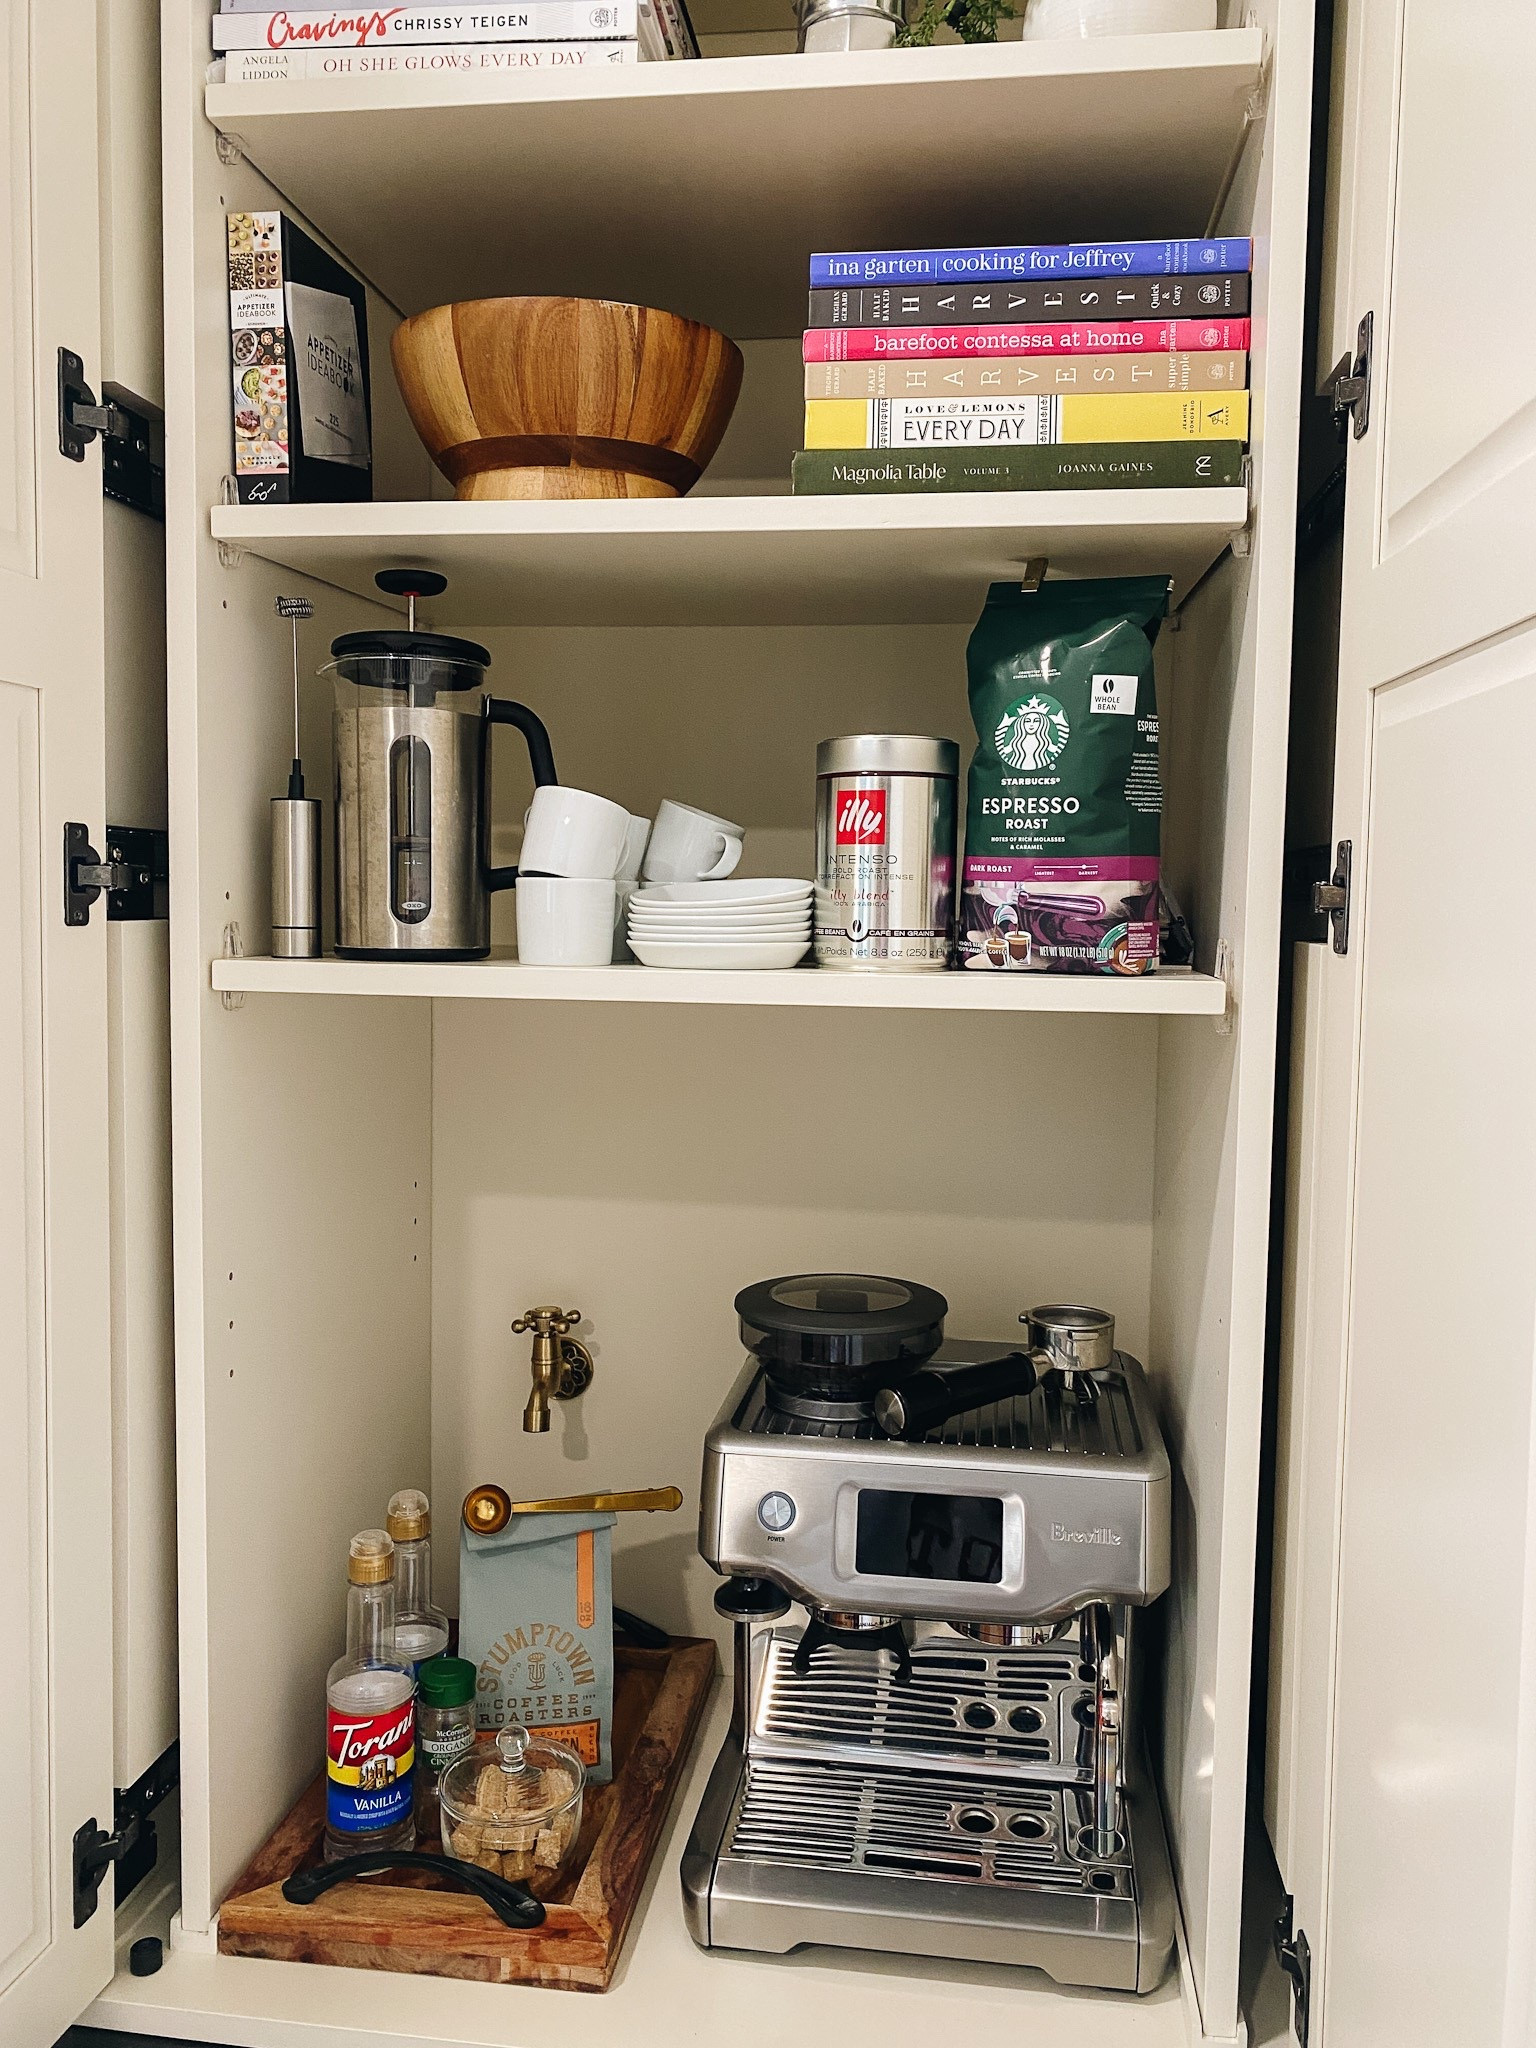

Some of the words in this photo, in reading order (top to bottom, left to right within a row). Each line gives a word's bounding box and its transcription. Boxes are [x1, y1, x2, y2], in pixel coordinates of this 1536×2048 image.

[267, 7, 409, 48] Cravings
[394, 17, 463, 31] CHRISSY
[470, 15, 528, 28] TEIGEN
[243, 55, 289, 65] ANGELA
[323, 58, 351, 73] OH
[359, 57, 398, 71] SHE
[405, 55, 472, 71] GLOWS
[480, 52, 542, 67] EVERY
[551, 51, 587, 65] DAY
[242, 71, 288, 80] LIDDON
[828, 258, 860, 276] ina
[864, 258, 930, 280] garten
[942, 252, 1025, 275] cooking
[1030, 251, 1059, 269] for
[1063, 248, 1135, 272] Jeffrey
[873, 293, 881, 318] HALF
[882, 289, 890, 321] BAKED
[1151, 283, 1160, 309] Quick
[1162, 291, 1170, 299] &
[1172, 284, 1182, 306] Cozy
[873, 333, 958, 352] barefoot
[964, 331, 1054, 350] contessa
[1059, 331, 1080, 347] at
[1086, 329, 1144, 347] home
[1158, 330, 1166, 345] ina
[1169, 322, 1177, 352] garten
[307, 333, 354, 378] APPETIZER
[868, 368, 876, 392] HALF
[878, 364, 886, 395] BAKED
[1168, 357, 1178, 388] super
[1179, 354, 1191, 391] simple
[904, 405, 945, 414] LOVE
[961, 402, 1026, 413] LEMONS
[903, 419, 973, 441] EVERY
[979, 418, 1026, 440] DAY
[832, 464, 902, 484] Magnolia
[905, 463, 947, 481] Table
[963, 467, 1000, 475] VOLUME
[1058, 463, 1104, 474] JOANNA
[1109, 462, 1154, 472] GAINES
[1094, 696, 1120, 704] WHOLE
[1097, 703, 1117, 711] BEAN
[1137, 720, 1159, 732] ESPRES
[982, 797, 1080, 814] ESPRESSO
[838, 798, 883, 840] illy
[1005, 818, 1048, 829] ROAST
[826, 854, 898, 864] INTENSO
[970, 864, 985, 872] DARK
[987, 865, 1012, 873] ROAST
[830, 889, 847, 902] illy
[854, 888, 889, 901] blend
[850, 948, 868, 956] Net
[870, 948, 888, 956] 8.8
[906, 948, 927, 958] (250
[1040, 946, 1049, 956] NET
[1049, 946, 1057, 956] WT
[1058, 947, 1065, 957] 18
[1066, 947, 1072, 957] OZ
[1050, 1522, 1121, 1546] Breville
[580, 1601, 591, 1613] 18
[476, 1622, 595, 1693] STUMPTOWN
[507, 1662, 521, 1685] GOOD
[552, 1661, 564, 1682] LUCK
[493, 1694, 579, 1710] COFFEE
[479, 1705, 592, 1723] ROASTERS
[332, 1700, 415, 1769] Torani
[431, 1734, 472, 1751] ORGANIC
[354, 1790, 402, 1811] VANILLA
